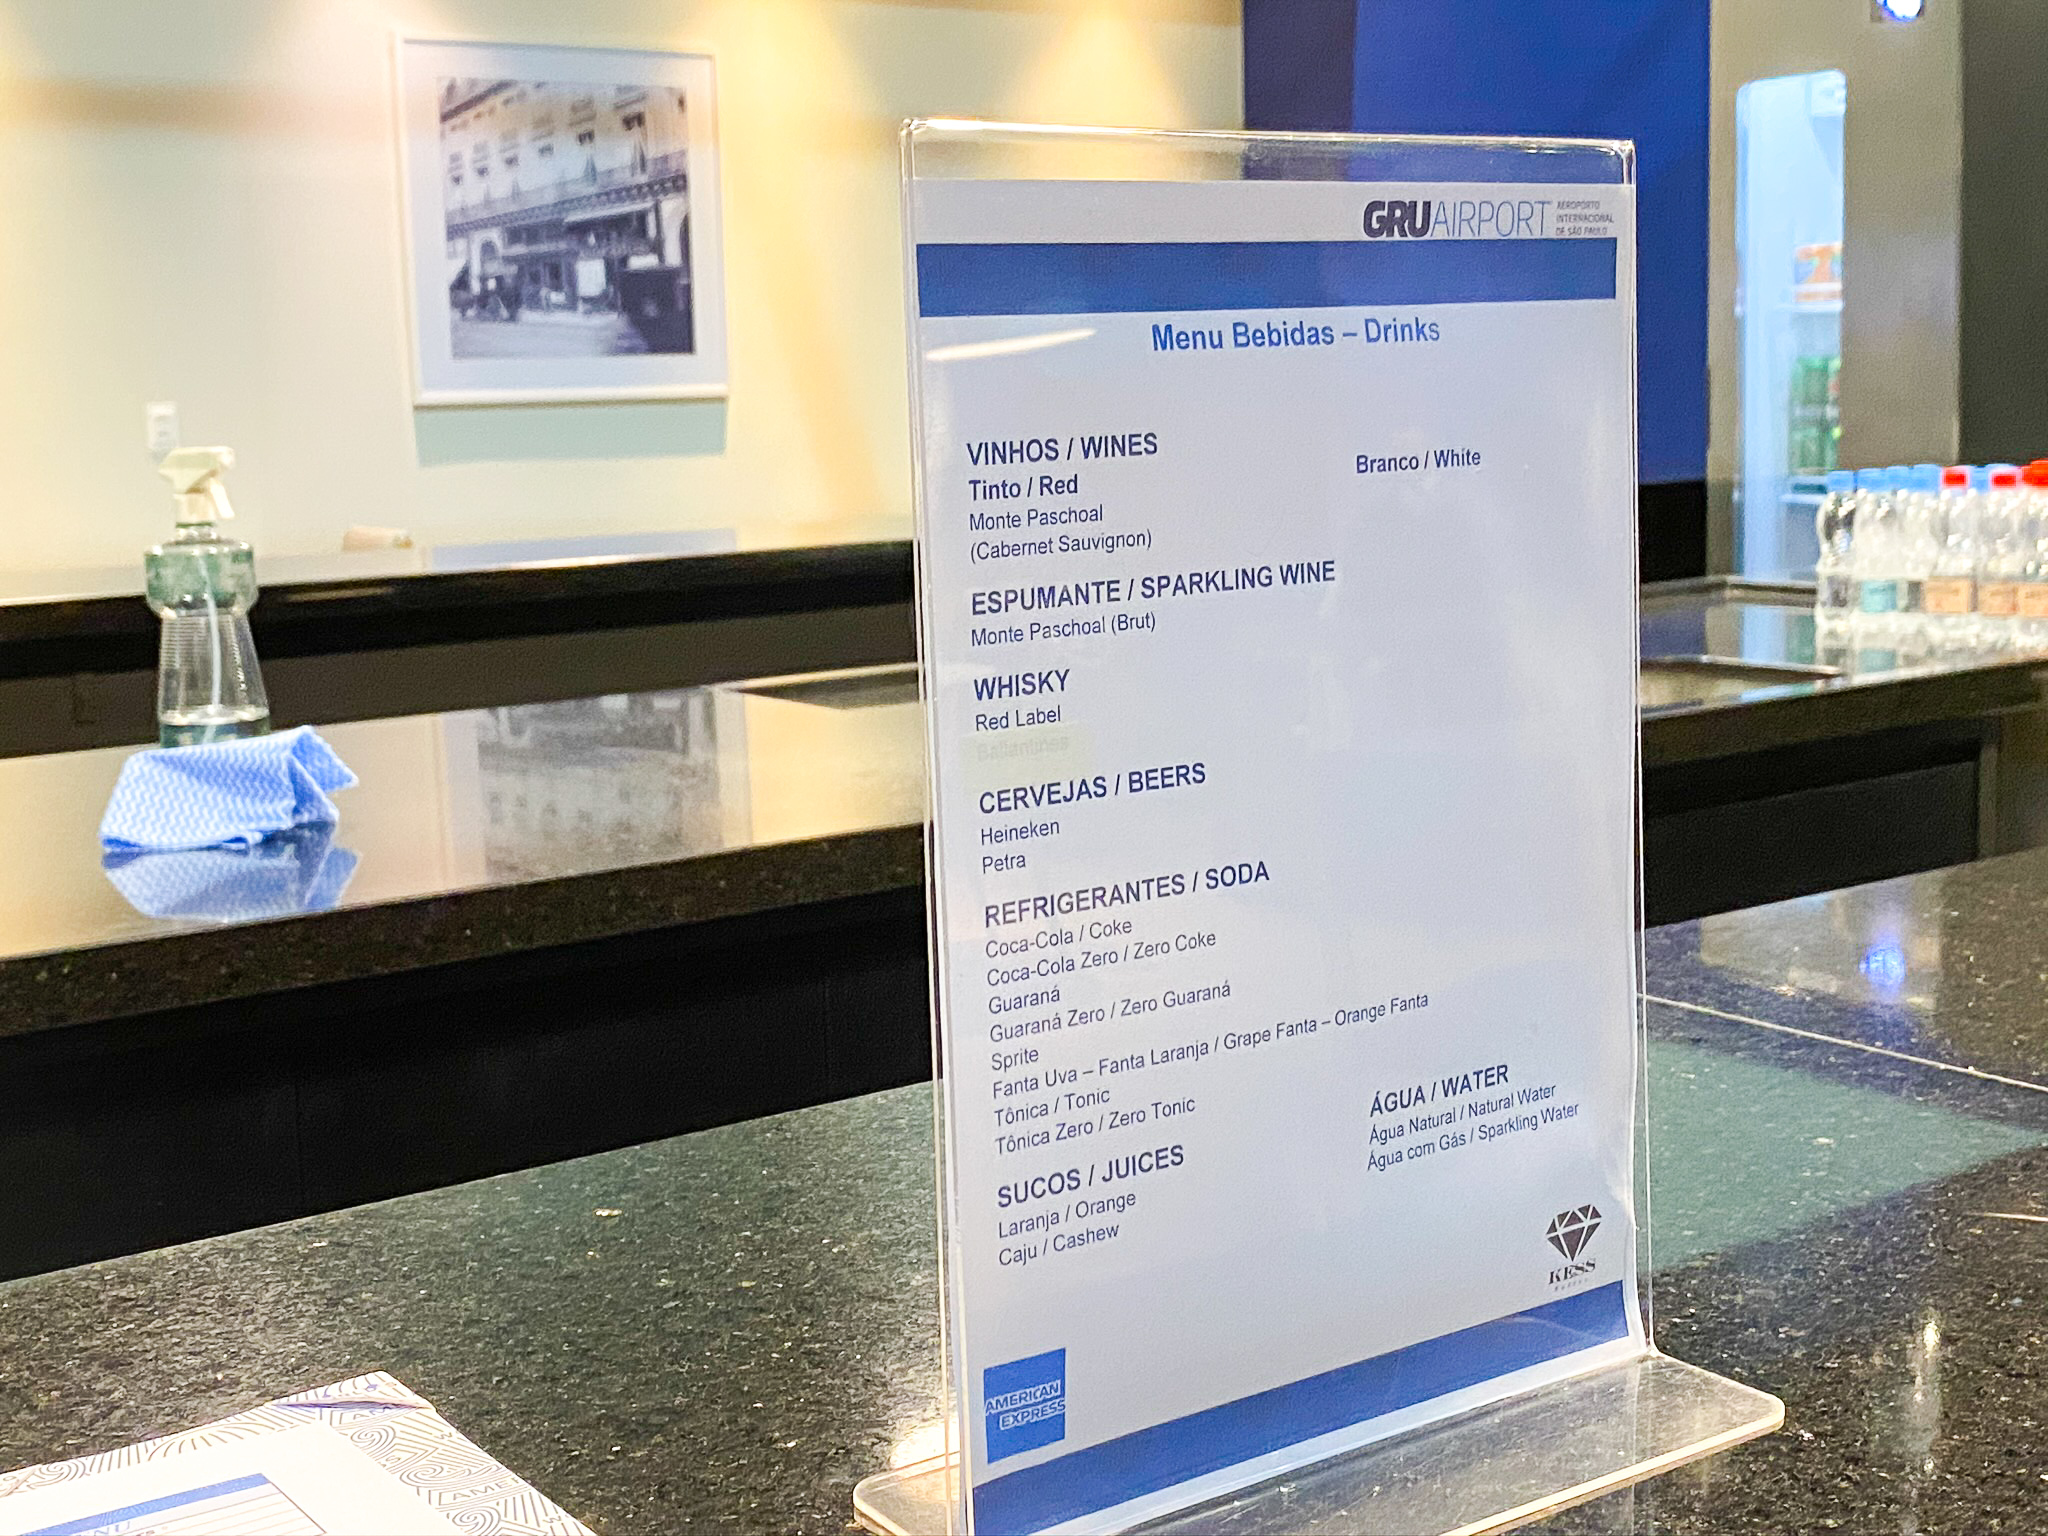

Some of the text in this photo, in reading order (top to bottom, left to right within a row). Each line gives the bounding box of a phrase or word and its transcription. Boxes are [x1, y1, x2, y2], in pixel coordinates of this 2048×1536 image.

[1151, 323, 1224, 352] Menu
[1232, 320, 1335, 349] Bebidas
[1364, 316, 1440, 344] Drinks
[965, 437, 1060, 467] VINHOS
[1079, 431, 1158, 460] WINES
[1356, 454, 1420, 474] Branco
[1433, 447, 1481, 469] White
[967, 479, 1022, 502] Tinto
[1039, 473, 1079, 497] Red
[969, 503, 1103, 532] Monte Paschoal
[970, 528, 1152, 565] (Cabernet Sauvignon)
[971, 579, 1121, 616] ESPUMANTE
[1140, 565, 1273, 600] SPARKLING
[1279, 559, 1336, 586] WINE
[971, 610, 1156, 647] Monte Paschoal (Brut)
[973, 668, 1071, 702] WHISKY
[975, 704, 1061, 732] Red Label
[979, 775, 1108, 815] CERVEJAS
[1128, 762, 1206, 794] BEERS
[980, 819, 1060, 846] Heineken
[982, 853, 1027, 875] Petra
[985, 873, 1186, 929] REFRIGERANTES
[1205, 860, 1270, 890] SODA
[985, 927, 1074, 959] Coca-Cola
[1089, 919, 1133, 940] Coke
[986, 955, 1076, 989] Coca-Cola
[1080, 950, 1119, 970] Zero
[1133, 941, 1171, 960] Zero
[1175, 931, 1217, 952] Coke
[988, 984, 1061, 1017] Guaraná
[989, 1011, 1062, 1043] Guaraná
[1067, 1008, 1106, 1028] Zero
[1120, 998, 1158, 1017] Zero
[1162, 979, 1231, 1008] Guaraná
[991, 1048, 1039, 1074] Sprite
[993, 1076, 1039, 1100] Fanta
[1045, 1068, 1078, 1088] Uva
[1098, 1053, 1145, 1077] Fanta
[1150, 1039, 1209, 1066] Laranja
[1223, 1029, 1272, 1050] Grape
[1276, 1018, 1317, 1040] Fanta
[1334, 1004, 1386, 1027] Orange
[1390, 993, 1429, 1015] Fanta
[993, 1103, 1049, 1128] Tônica
[1063, 1089, 1111, 1111] Tonic
[1369, 1087, 1426, 1118] ÁGUA
[1441, 1063, 1509, 1098] WATER
[994, 1130, 1051, 1155] Tônica
[1055, 1121, 1094, 1142] Zero
[1108, 1109, 1146, 1130] Zero
[1150, 1098, 1196, 1120] Tonic
[1368, 1123, 1405, 1146] Água
[1409, 1106, 1457, 1135] Natural
[1468, 1092, 1515, 1119] Natural
[1516, 1084, 1557, 1106] Water
[1367, 1149, 1404, 1172] Água
[1407, 1142, 1436, 1160] com
[1438, 1131, 1467, 1151] Gás
[1478, 1114, 1539, 1143] Sparkling
[1540, 1103, 1579, 1124] Water
[997, 1168, 1081, 1209] SUCOS
[1101, 1144, 1184, 1183] JUICES
[998, 1211, 1060, 1239] Laranja
[1075, 1193, 1137, 1219] Orange
[998, 1243, 1038, 1267] Caju
[1053, 1224, 1120, 1252] Cashew
[1548, 1258, 1596, 1284] KESS
[985, 1381, 1060, 1414] AMERICAN
[1001, 1399, 1066, 1429] EXPRESS
